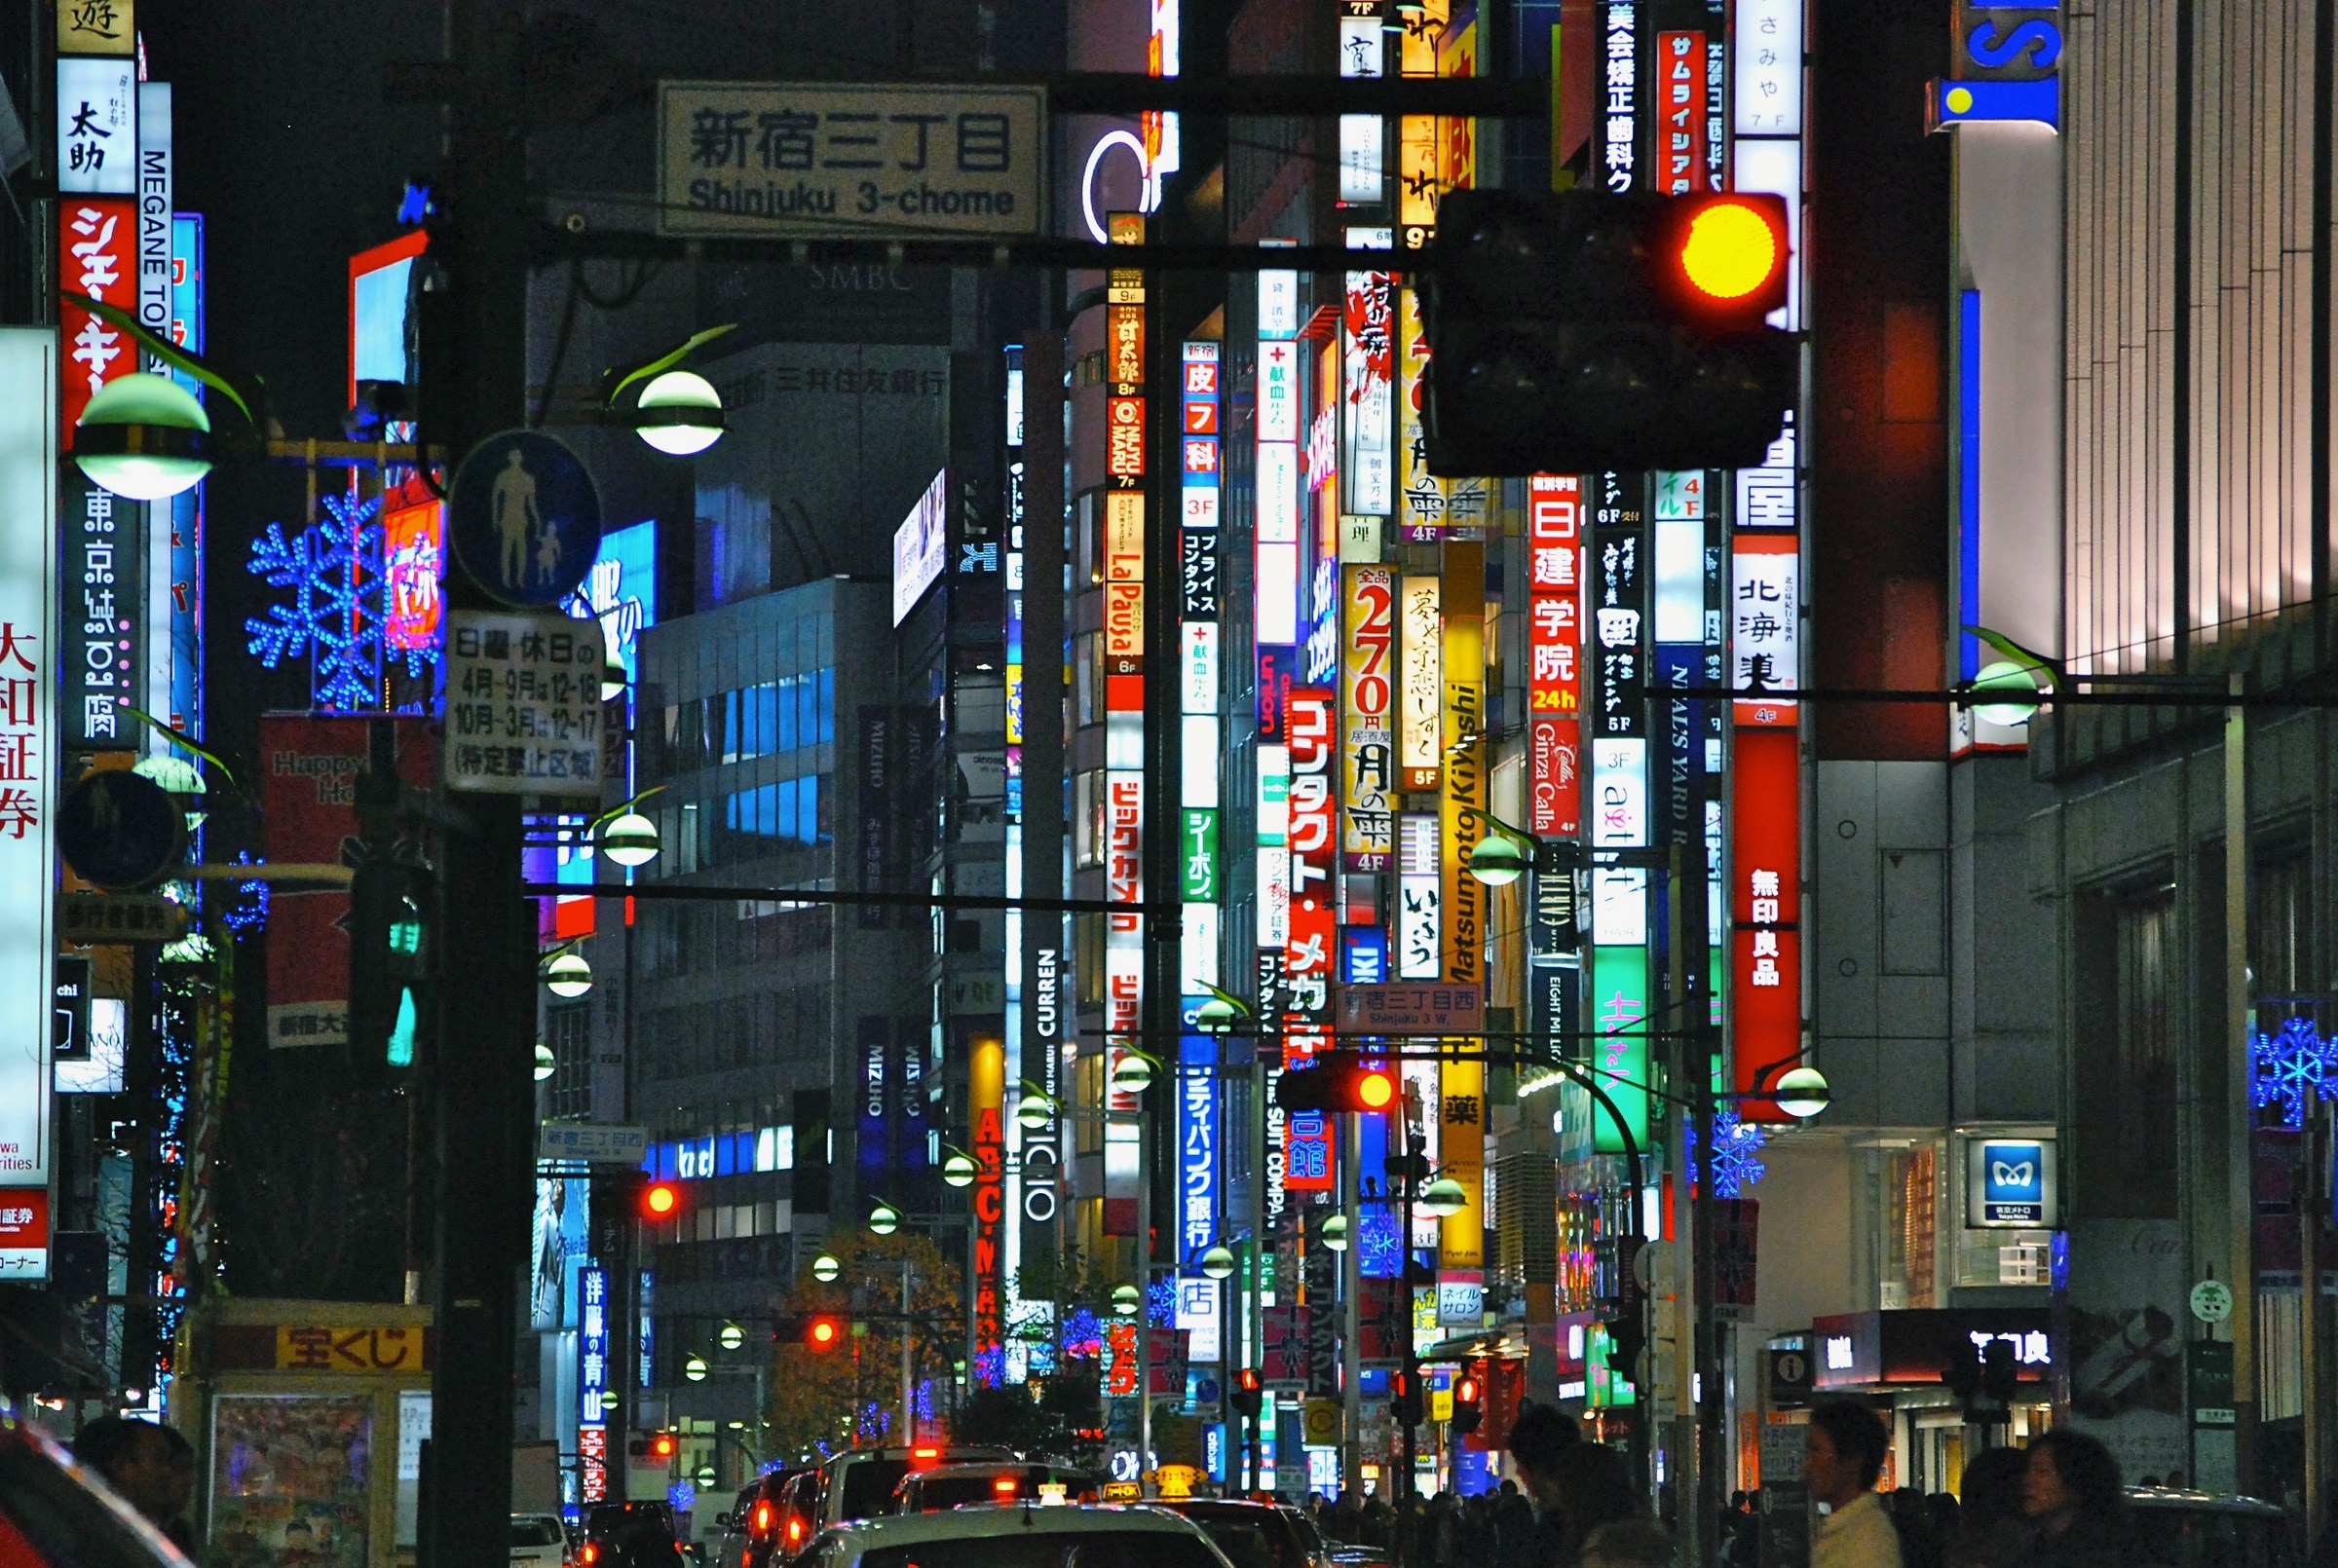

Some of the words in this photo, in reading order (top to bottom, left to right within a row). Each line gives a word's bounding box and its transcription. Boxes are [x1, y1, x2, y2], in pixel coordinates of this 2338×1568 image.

[1350, 2, 1374, 16] 7F
[67, 100, 113, 174] 太助
[690, 108, 1010, 173] 新宿三丁目
[689, 179, 837, 216] Shinjuku
[857, 181, 1015, 216] 3-chome
[143, 151, 166, 275] MEGANE
[811, 265, 915, 291] SMBC
[1187, 344, 1216, 357] 新宿
[1117, 383, 1136, 396] 8F
[1186, 364, 1216, 471] 皮フ科
[1117, 474, 1135, 488] 7F
[1188, 499, 1214, 515] 3F
[1597, 508, 1621, 524] 6F
[1412, 527, 1437, 541] 4F
[1184, 535, 1200, 613] コンタクト
[1357, 569, 1390, 584] 全品
[1534, 501, 1575, 681] 日建学院
[1739, 579, 1782, 685] 北海道
[1118, 660, 1136, 674] 6F
[1532, 691, 1576, 709] 24h
[1607, 717, 1632, 731] 5F
[1754, 709, 1776, 723] 4F
[1350, 729, 1391, 744] 居酒屋
[1535, 723, 1556, 780] Ginza
[1414, 770, 1436, 785] 5F
[1535, 781, 1556, 832] Calla
[1357, 853, 1384, 872] 4F
[1752, 869, 1780, 989] 無印良品
[1343, 990, 1475, 1011] 新宿三丁目西
[1370, 1012, 1419, 1026] Shinjuku
[868, 1045, 884, 1117] MIZUHO
[1445, 1095, 1479, 1125] 薬
[1267, 1107, 1285, 1148] SUIT
[0, 1208, 34, 1224] 証券
[1995, 1205, 2031, 1215] 東京メトロ
[1443, 1288, 1480, 1300] ネイル
[1443, 1302, 1480, 1315] サロン
[286, 1325, 408, 1369] 宝くじ
[583, 1271, 604, 1422] 洋服の青山
